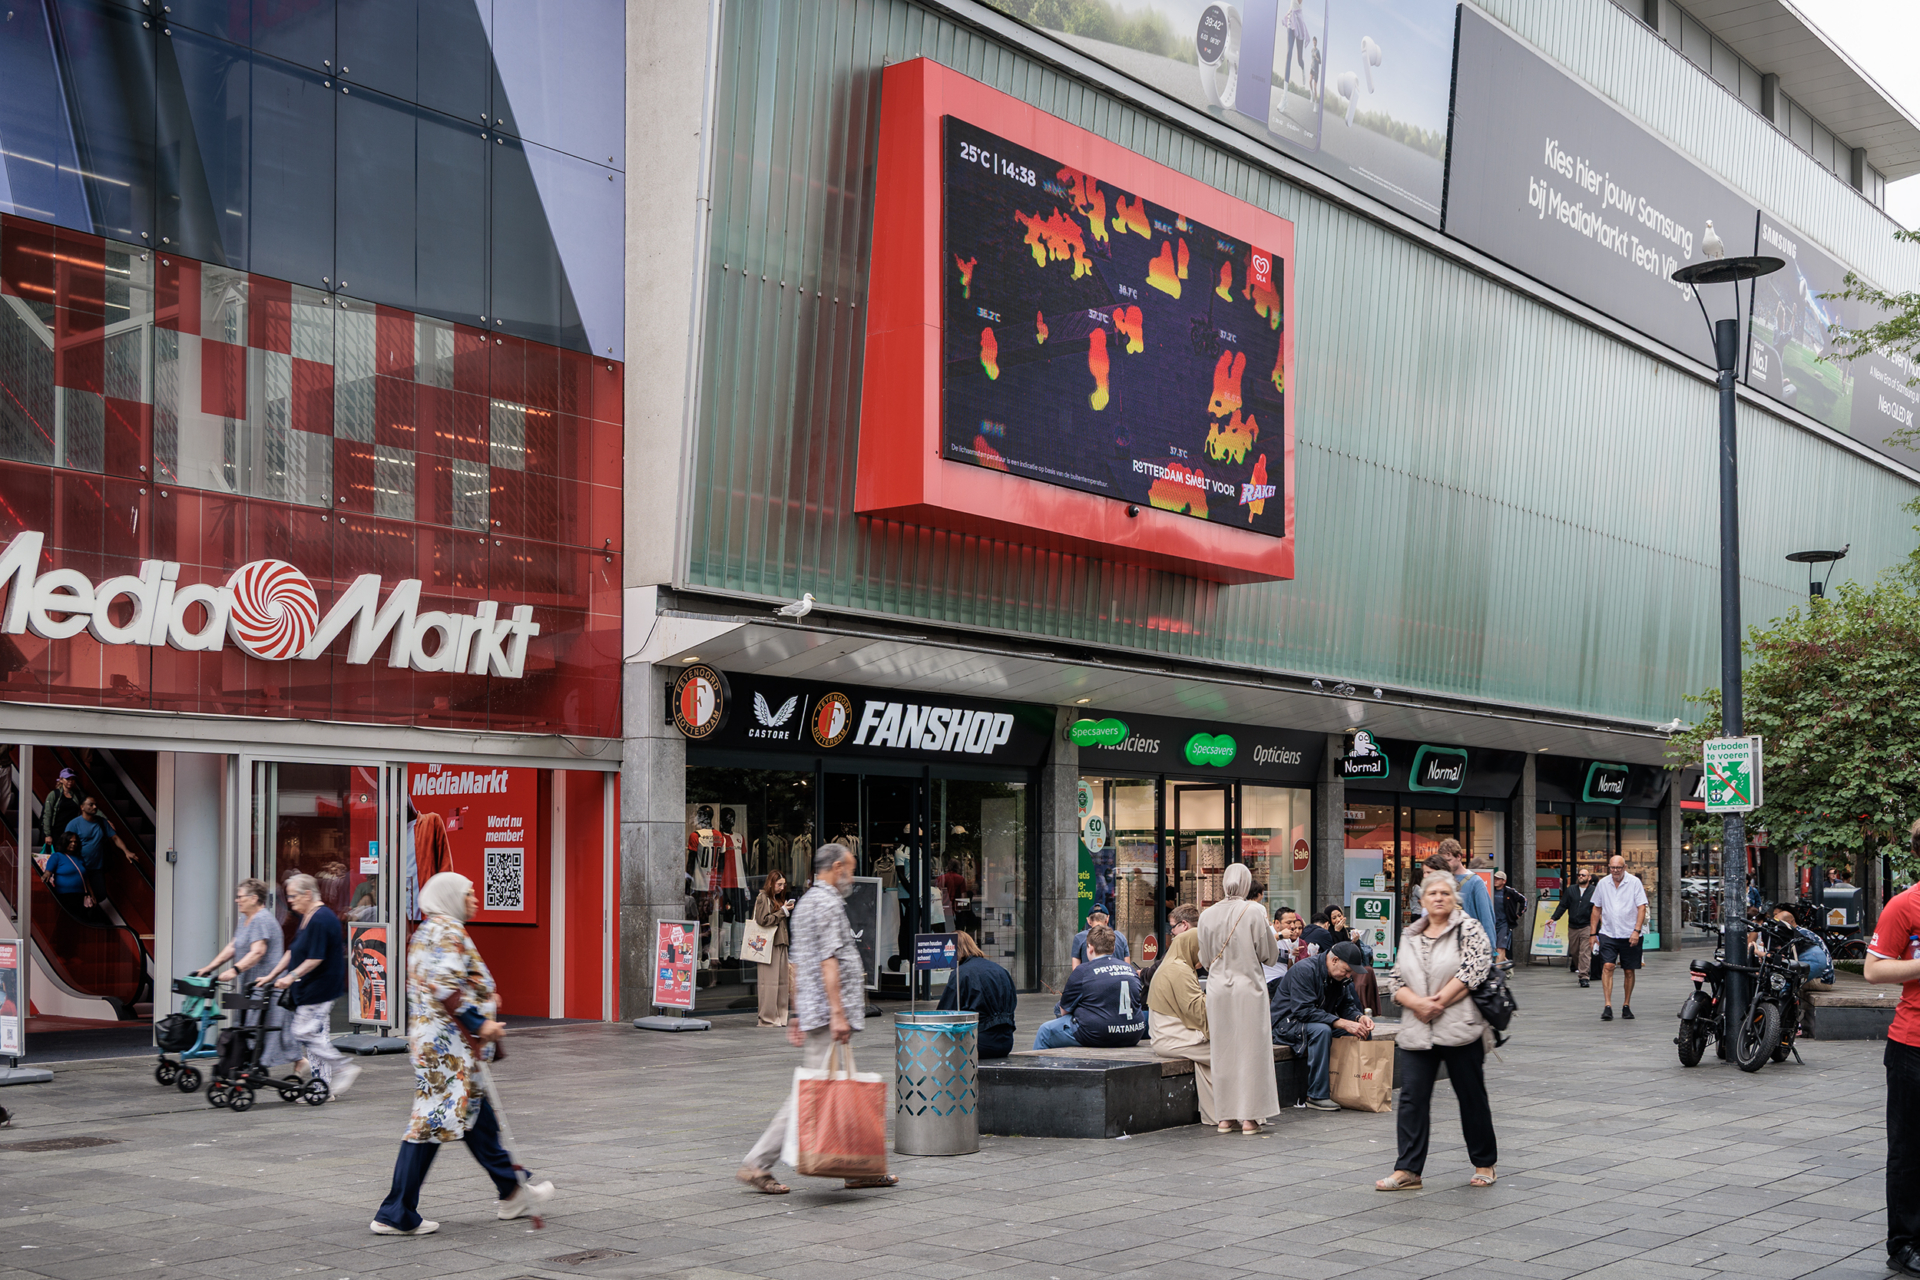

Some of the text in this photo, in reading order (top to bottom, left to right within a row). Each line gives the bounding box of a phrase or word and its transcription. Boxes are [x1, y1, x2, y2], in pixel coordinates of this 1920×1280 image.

[1001, 158, 1037, 187] 14:38
[1544, 137, 1694, 260] Kies hier jouw Samsung
[1528, 175, 1547, 220] bij
[1548, 187, 1628, 258] MediaMarkt
[1631, 235, 1659, 276] Tech
[1762, 223, 1797, 260] SAMSUNG
[1256, 273, 1267, 284] OLA
[1752, 348, 1769, 373] No.1
[1878, 394, 1891, 416] Neo
[1891, 402, 1907, 424] QLED
[1212, 480, 1236, 498] VOOR
[676, 668, 720, 694] FEYENOORD
[818, 694, 850, 714] FEYENOORD
[676, 710, 720, 736] ROTTERDAM
[852, 700, 1015, 755] FANSHOP
[1072, 727, 1119, 738] Specsavers
[748, 728, 790, 740] CASTORE
[813, 726, 847, 746] ROTTERDAM
[1192, 742, 1234, 756] Specsavers
[1253, 744, 1302, 766] Opticiens
[1706, 741, 1749, 751] Verboden
[1718, 752, 1749, 760] voeren
[428, 763, 442, 775] my
[1344, 759, 1381, 774] Normal
[1427, 759, 1463, 781] Normal
[412, 769, 509, 796] MediaMarkt
[1598, 774, 1625, 794] Normal
[487, 814, 523, 828] Word nu
[1089, 819, 1102, 832] €0
[485, 829, 525, 842] member!
[1294, 848, 1309, 860] Sale
[1364, 900, 1382, 913] €0
[1143, 943, 1157, 953] Sale
[1119, 980, 1133, 1020] 4
[1107, 1021, 1146, 1034] WATANABE
